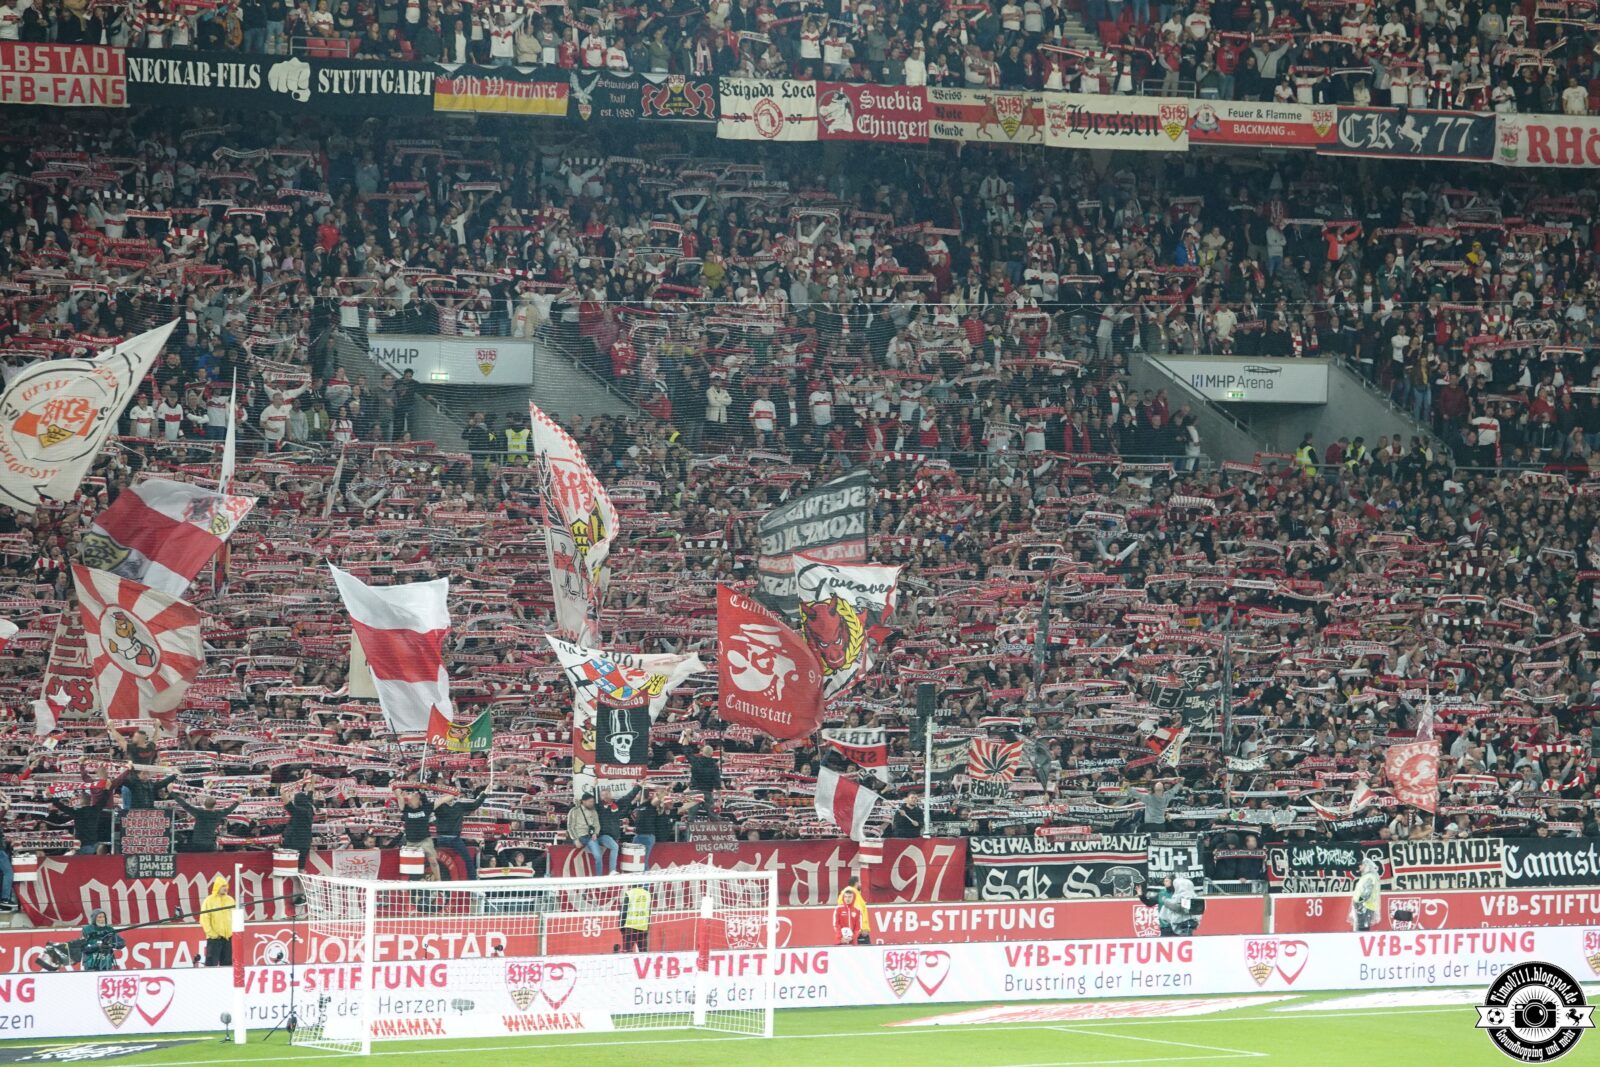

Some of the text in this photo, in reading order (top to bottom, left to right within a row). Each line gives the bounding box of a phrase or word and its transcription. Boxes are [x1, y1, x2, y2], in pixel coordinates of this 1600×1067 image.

[128, 57, 436, 96] NECKAR-FILS STUTTGART
[453, 75, 481, 97] Old
[719, 78, 775, 99] Brigada
[859, 90, 922, 112] Suebia
[1228, 108, 1302, 120] Feuer & Flamme
[857, 113, 929, 138] Ehingen
[934, 124, 964, 137] Garde
[1233, 124, 1286, 136] BACKNANG
[1435, 117, 1475, 153] 77
[384, 348, 419, 364] MHP
[1206, 375, 1274, 389] MHP Arena
[726, 694, 792, 725] Cannstatt
[600, 763, 643, 777] Cannstatt
[21, 840, 74, 848] COMMANDO
[970, 834, 1147, 853] SCHWABEN KOMPANIE
[1393, 838, 1501, 866] SÜDBANDE
[139, 862, 174, 870] IMMER
[155, 854, 174, 862] BIST
[1147, 846, 1204, 872] 50+1
[1503, 842, 1600, 880] Cannst
[890, 844, 956, 903] 97
[1396, 869, 1504, 889] STUTTGART
[1306, 898, 1323, 917] 36
[582, 918, 601, 937] 35
[875, 907, 1056, 933] VfB-STIFTUNG
[1004, 940, 1193, 968] VfB-STIFTUNG
[1359, 931, 1536, 957] VfB-STIFTUNG
[1360, 963, 1436, 983] Brustring
[1449, 961, 1474, 978] der
[727, 982, 755, 1001] der
[1005, 971, 1193, 995] Brustring der Herzen
[378, 995, 447, 1015] Herzen
[502, 1011, 586, 1032] WINAMAX
